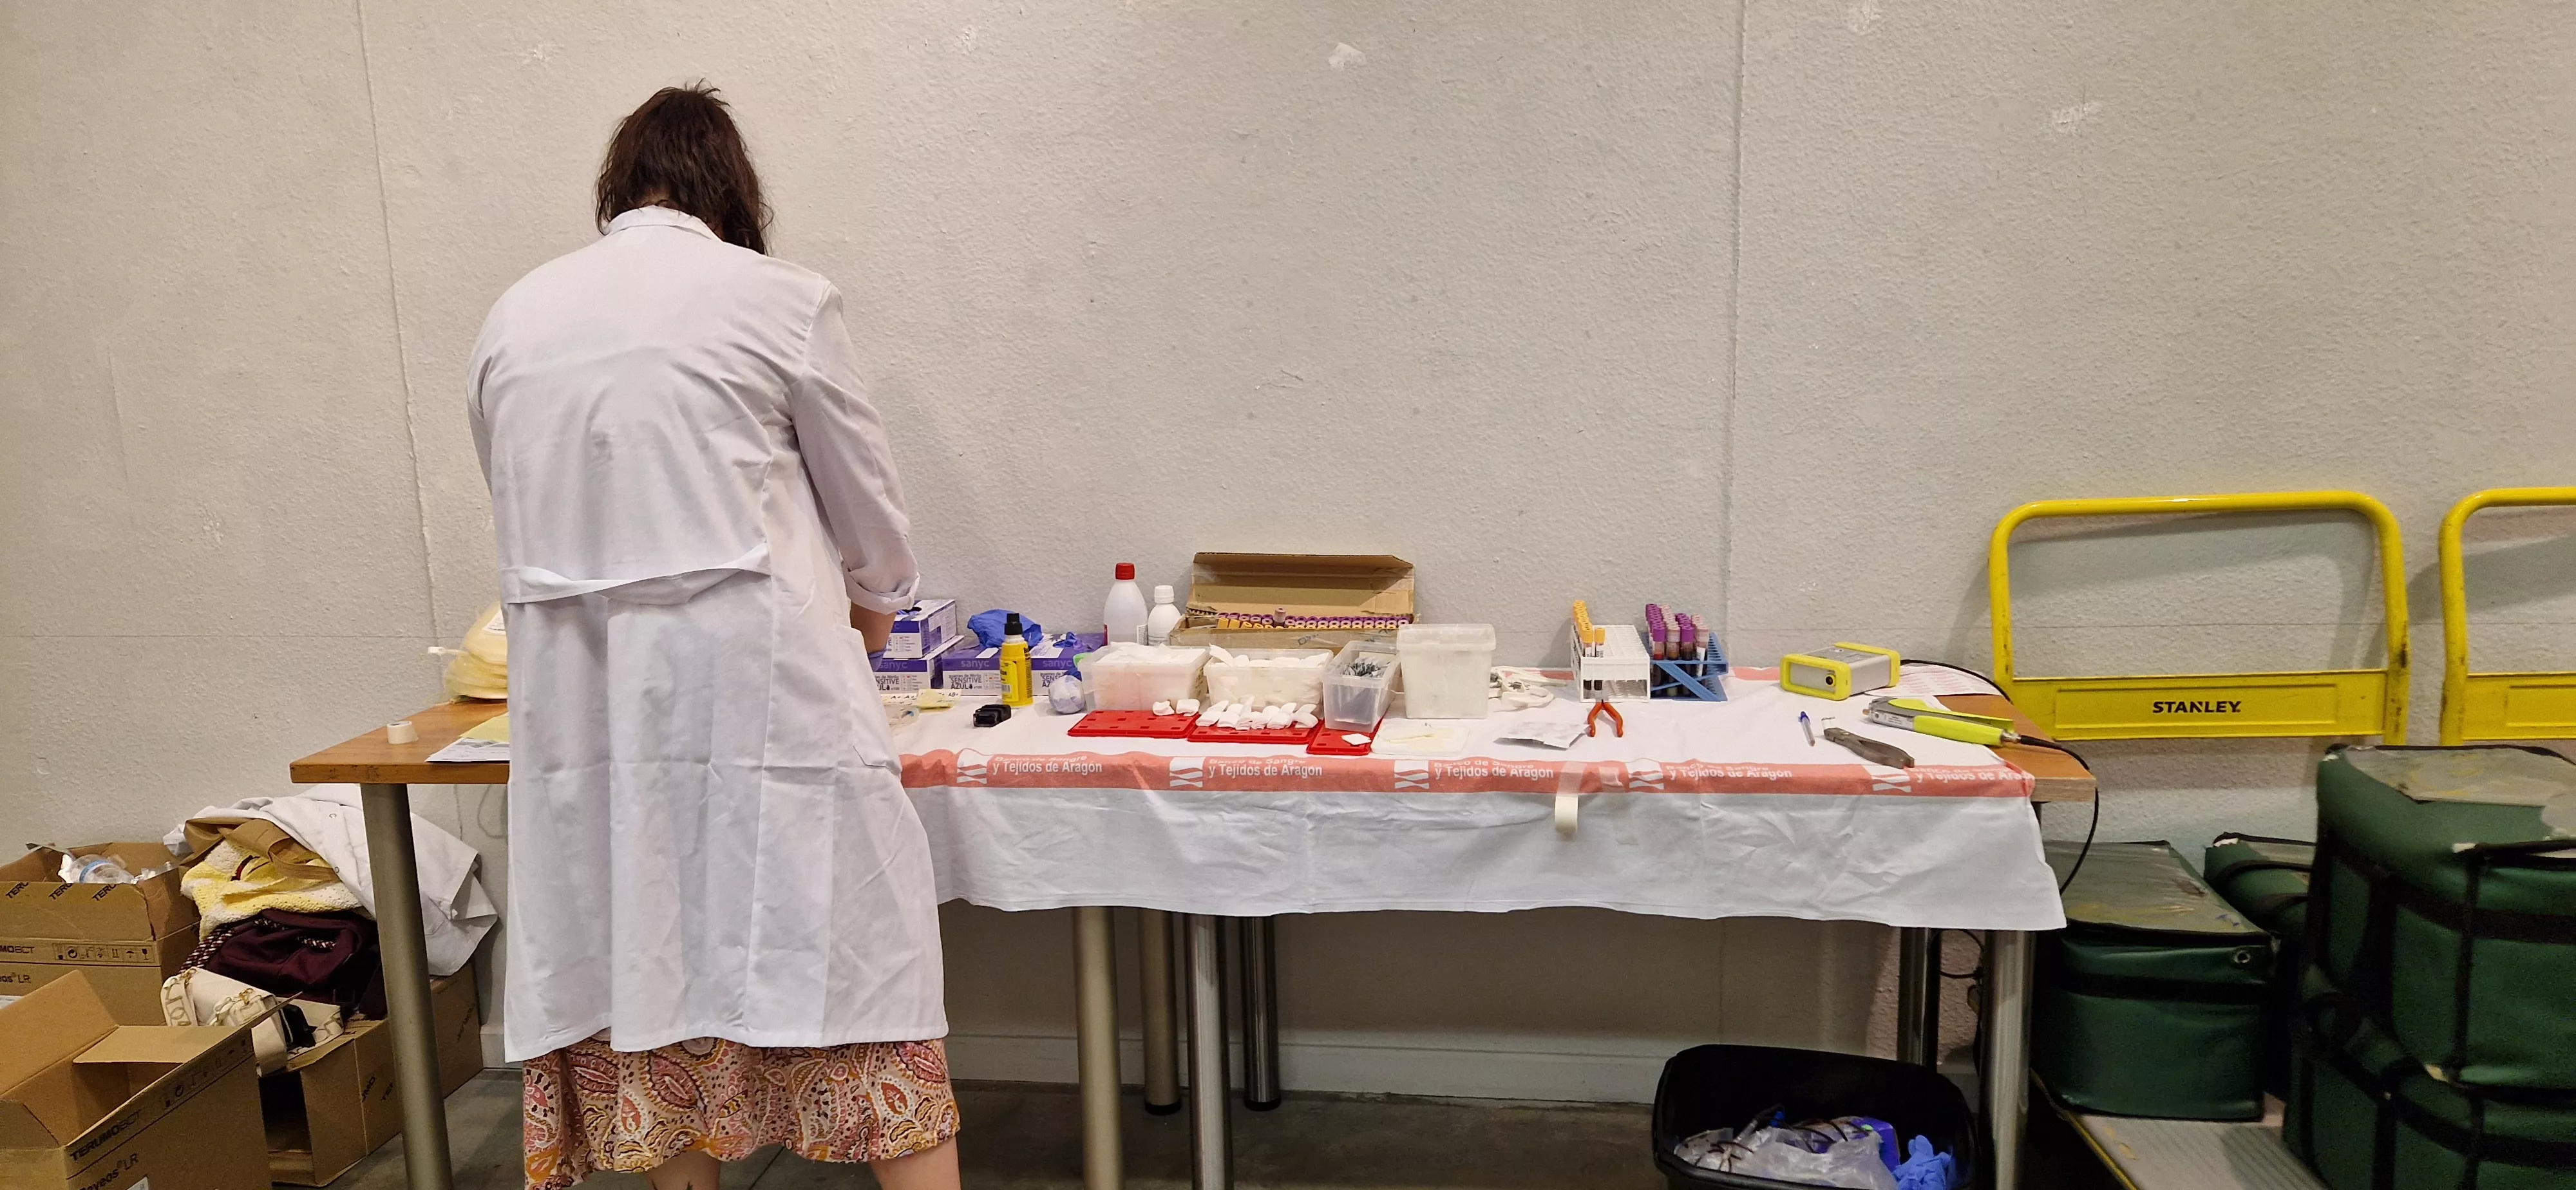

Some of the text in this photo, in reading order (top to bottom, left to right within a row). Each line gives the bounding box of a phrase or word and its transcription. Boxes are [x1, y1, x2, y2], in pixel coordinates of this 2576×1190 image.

[960, 658, 990, 670] sanyc
[1042, 658, 1073, 670] sanyc
[992, 760, 1103, 776] y Tejidos de Aragón
[1208, 766, 1216, 779] y
[1218, 764, 1260, 779] Tejidos
[1264, 764, 1278, 776] de
[1434, 768, 1443, 780] y
[1445, 766, 1489, 780] Tejidos
[1492, 766, 1506, 777] de
[1669, 770, 1676, 781] y
[1680, 768, 1725, 781] Tejidos
[1915, 773, 1923, 783] y
[1979, 771, 1996, 780] de
